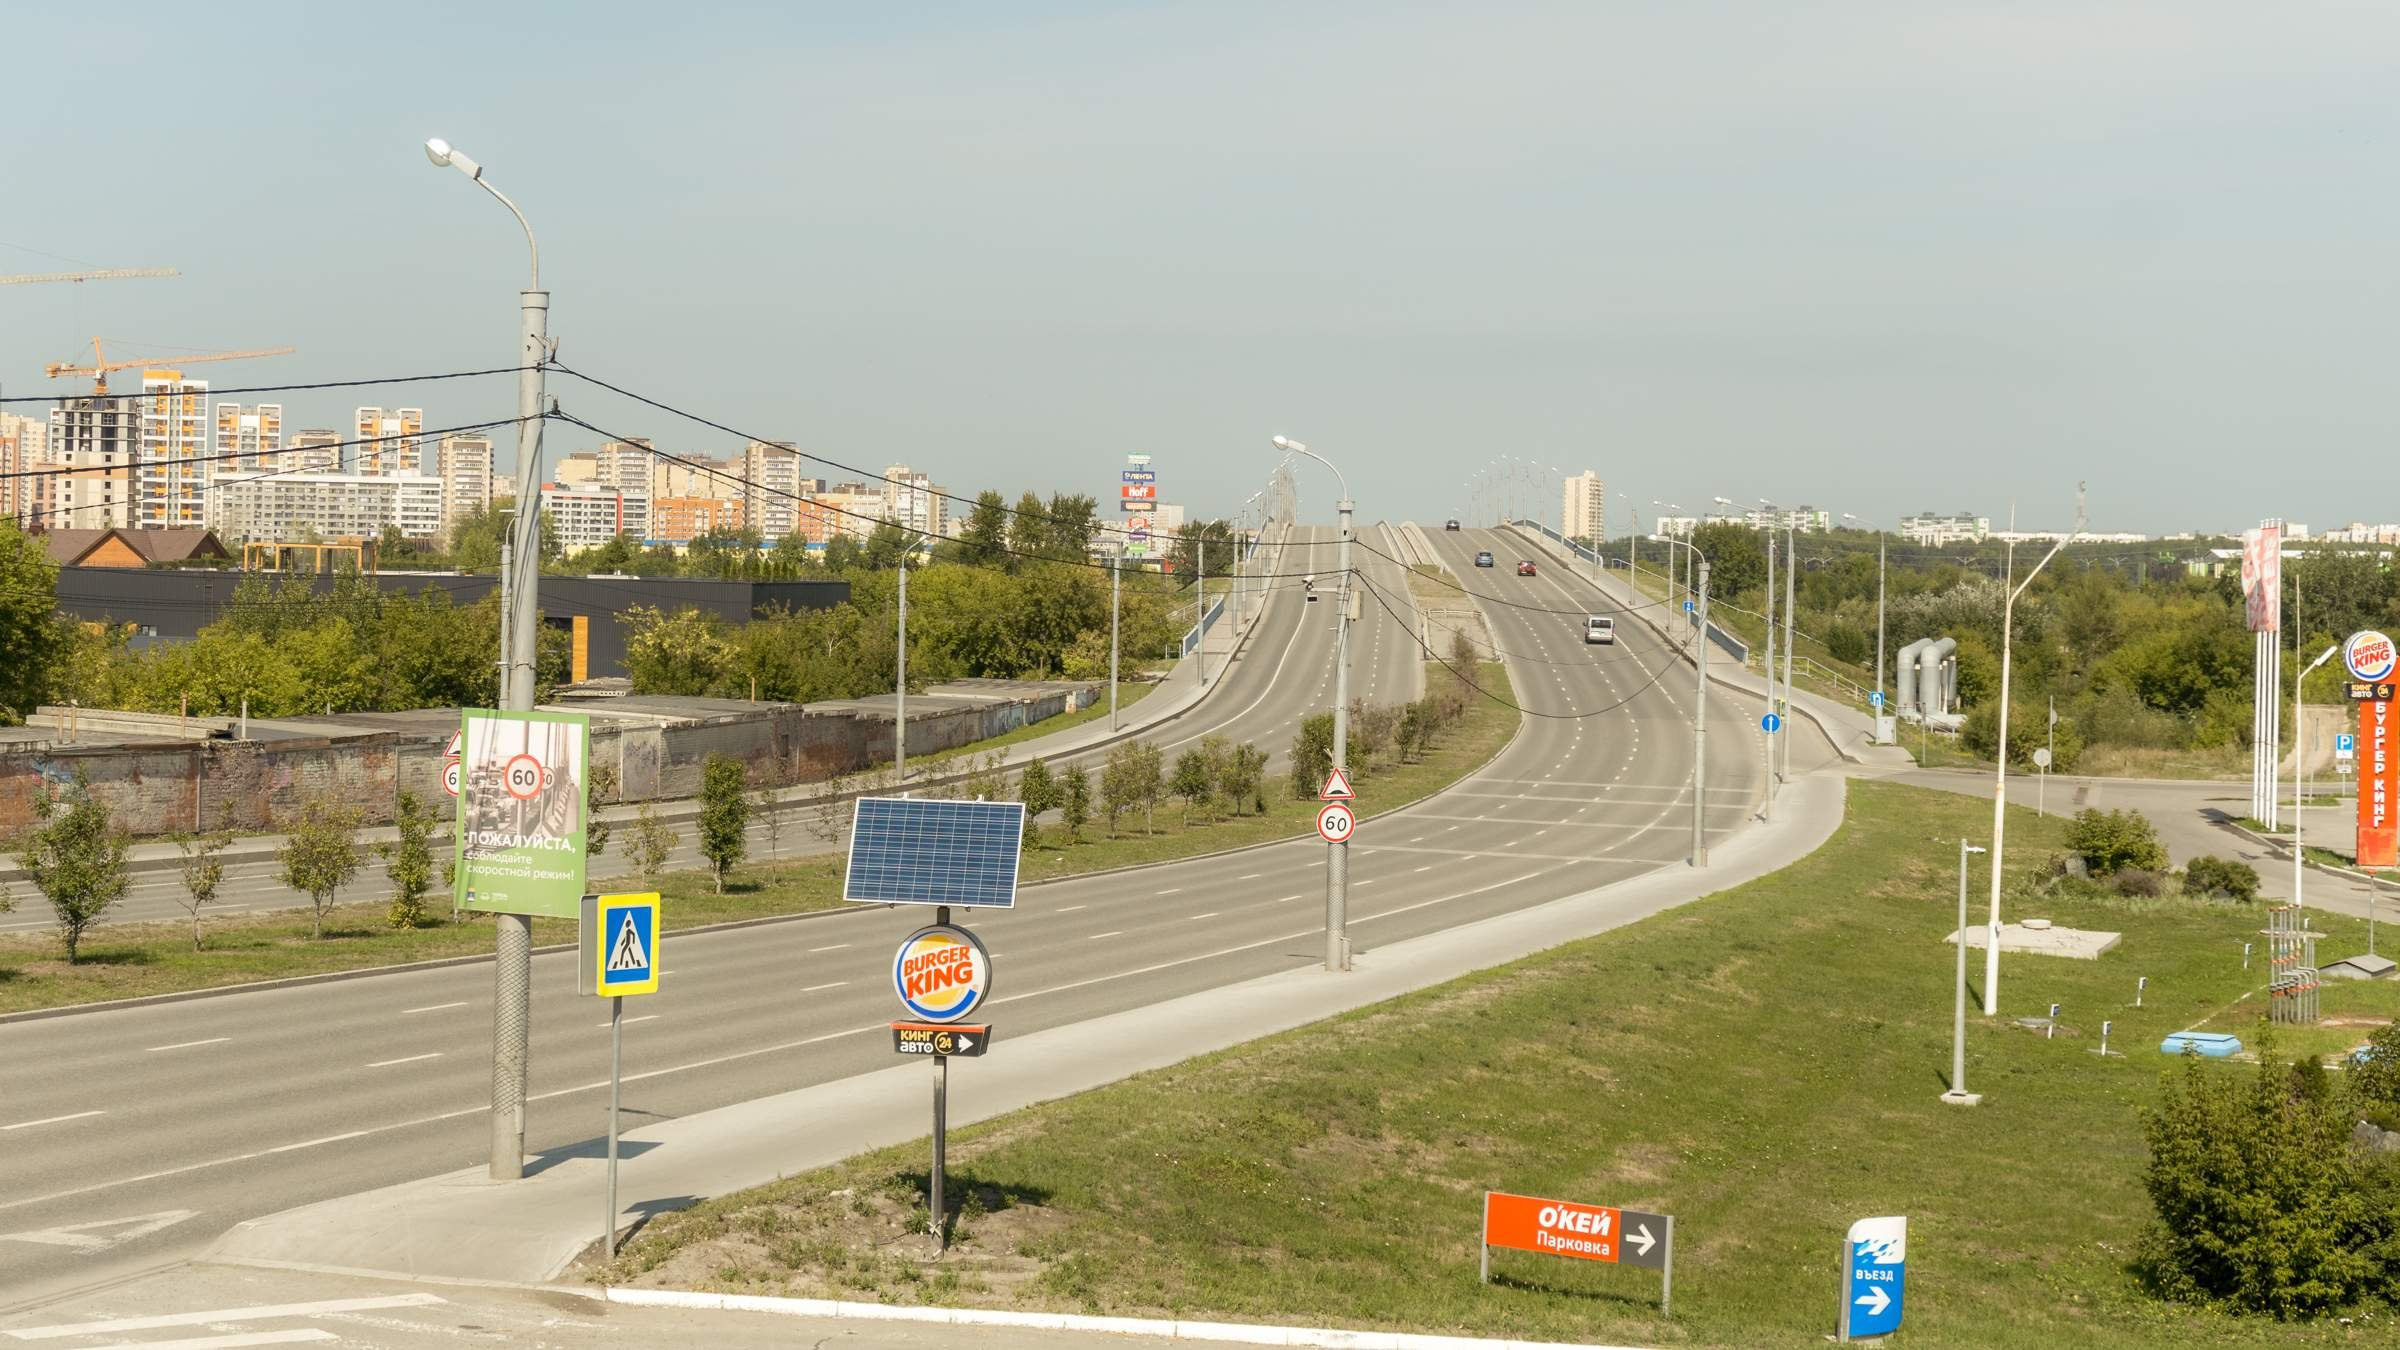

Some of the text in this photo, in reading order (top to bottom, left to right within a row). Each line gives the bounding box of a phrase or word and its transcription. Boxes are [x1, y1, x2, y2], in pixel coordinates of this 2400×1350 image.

[2352, 641, 2388, 658] BURGER
[2354, 649, 2391, 670] KING
[2373, 701, 2386, 828] БУРГЕР КИНГ
[512, 769, 535, 786] 60
[1325, 815, 1347, 832] 60
[468, 831, 576, 853] ПОЖАЛУЙСТА,
[466, 851, 533, 865] соблюдайте
[466, 864, 575, 881] скоростной режим!
[904, 946, 971, 976] BURGER
[906, 962, 973, 1000] KING
[900, 1030, 934, 1042] КИНГ
[938, 1037, 952, 1049] 24
[900, 1041, 934, 1053] авто
[1536, 1230, 1610, 1256] Парковка
[1855, 1269, 1894, 1282] ВЪЕЗД
